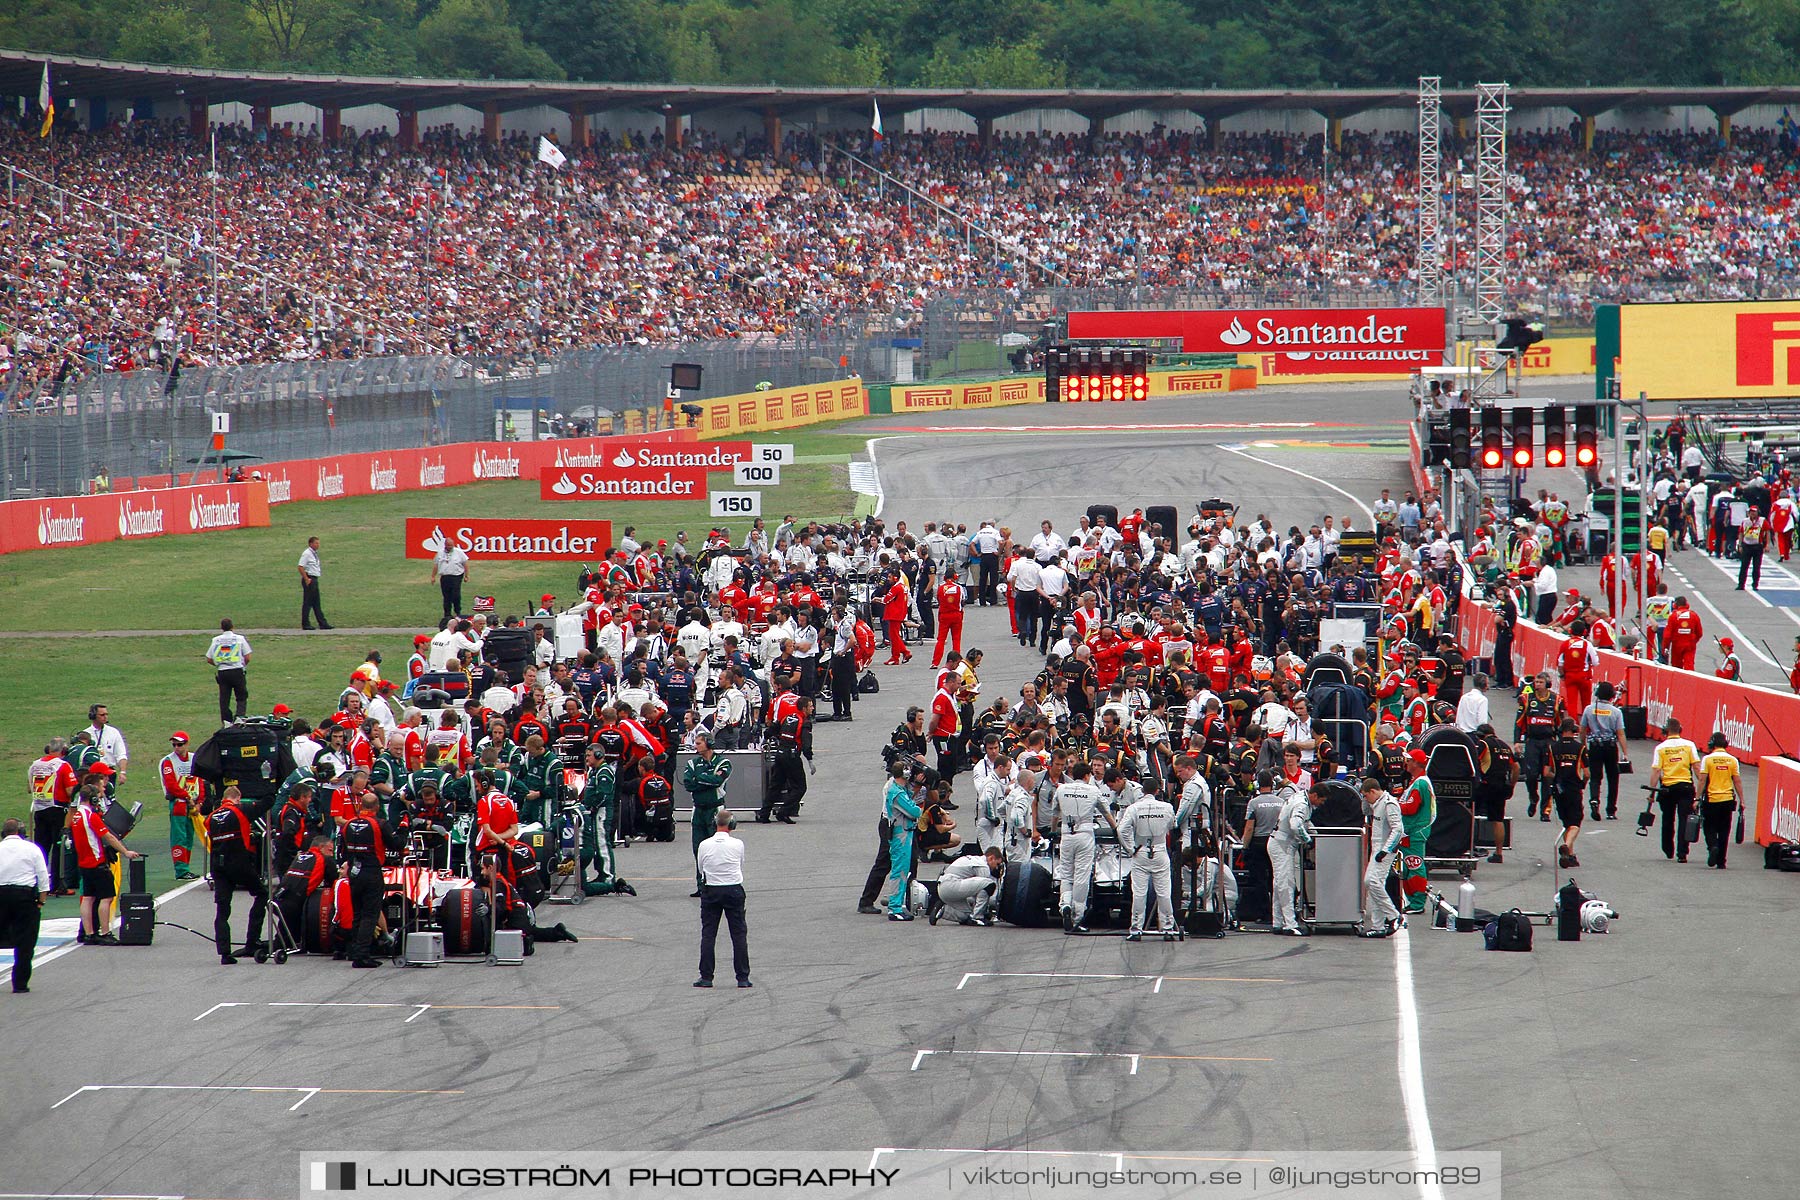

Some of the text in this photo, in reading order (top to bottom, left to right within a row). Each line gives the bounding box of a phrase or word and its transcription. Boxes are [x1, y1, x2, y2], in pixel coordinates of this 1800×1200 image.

[1256, 315, 1408, 345] Santander
[1168, 373, 1223, 392] PIRELLI
[905, 389, 953, 407] PIRELLI
[963, 386, 992, 404] PIRELLI
[765, 396, 784, 422] PIRELLI
[217, 416, 222, 430] 1
[482, 447, 520, 478] Santander
[638, 446, 742, 467] Santander
[763, 449, 782, 461] 50
[580, 472, 695, 495] Santander
[742, 467, 773, 480] 100
[126, 496, 164, 535] Santander
[198, 489, 241, 529] Santander
[718, 497, 753, 512] 150
[46, 503, 84, 544] Santander
[456, 527, 597, 554] Santander
[1722, 703, 1755, 753] Santander
